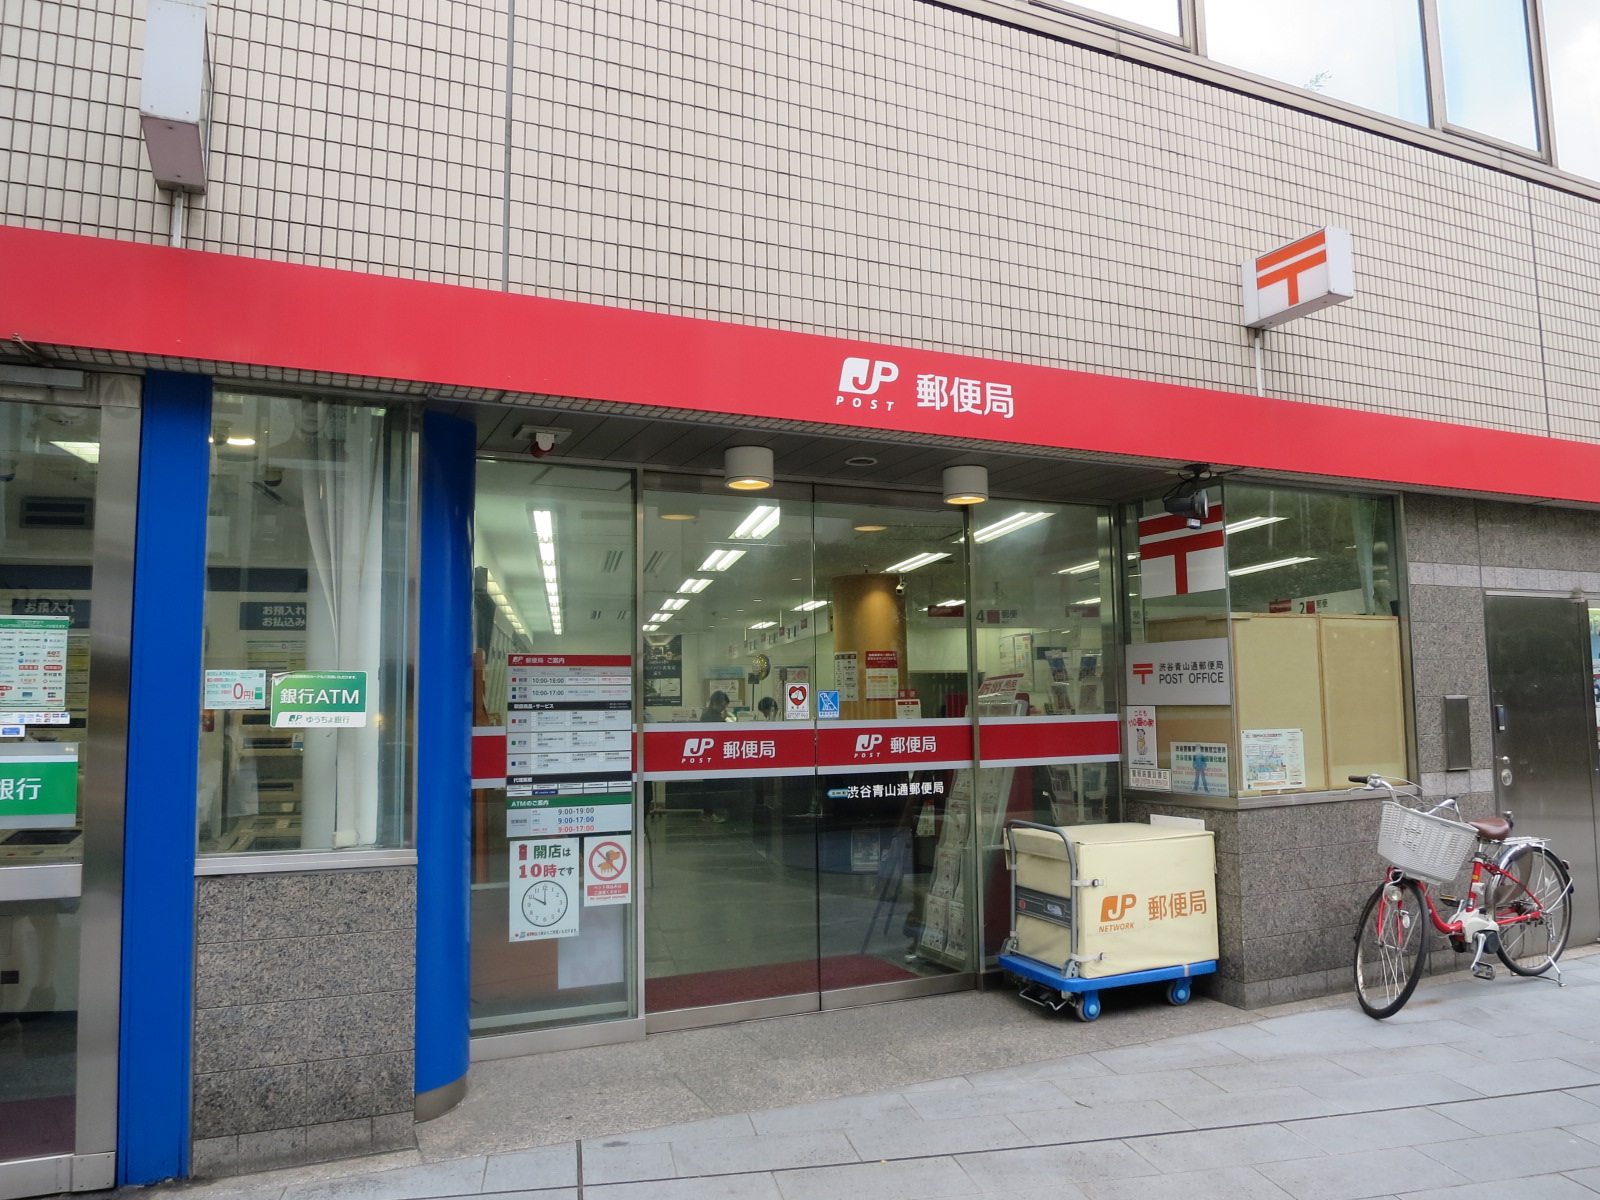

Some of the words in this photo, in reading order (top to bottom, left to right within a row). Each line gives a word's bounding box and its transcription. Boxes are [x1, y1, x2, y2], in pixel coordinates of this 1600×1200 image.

[916, 374, 1014, 418] 郵便局
[835, 395, 895, 412] POST
[262, 606, 306, 616] お預入れ
[1300, 602, 1306, 614] 2
[262, 618, 306, 626] お払込み
[976, 610, 985, 623] 4
[1159, 660, 1224, 672] 渋谷青山通郵便局
[1159, 673, 1184, 684] POST
[1188, 672, 1224, 684] OFFICE
[280, 688, 360, 704] 銀行ATM
[306, 716, 350, 724] ゆうちょ銀行
[723, 740, 776, 760] 郵便局
[890, 736, 936, 754] 郵便局
[847, 782, 944, 799] 渋谷青山通郵便局
[510, 800, 549, 808] ATMのご案内
[558, 807, 594, 815] 9:00-19:00
[558, 816, 594, 824] 9:00-17:00
[558, 825, 594, 833] 9:00-17:00
[533, 844, 572, 860] 開店は
[519, 864, 574, 878] 10時です
[1148, 890, 1207, 922] 郵便局
[1098, 922, 1135, 933] NETWORK
